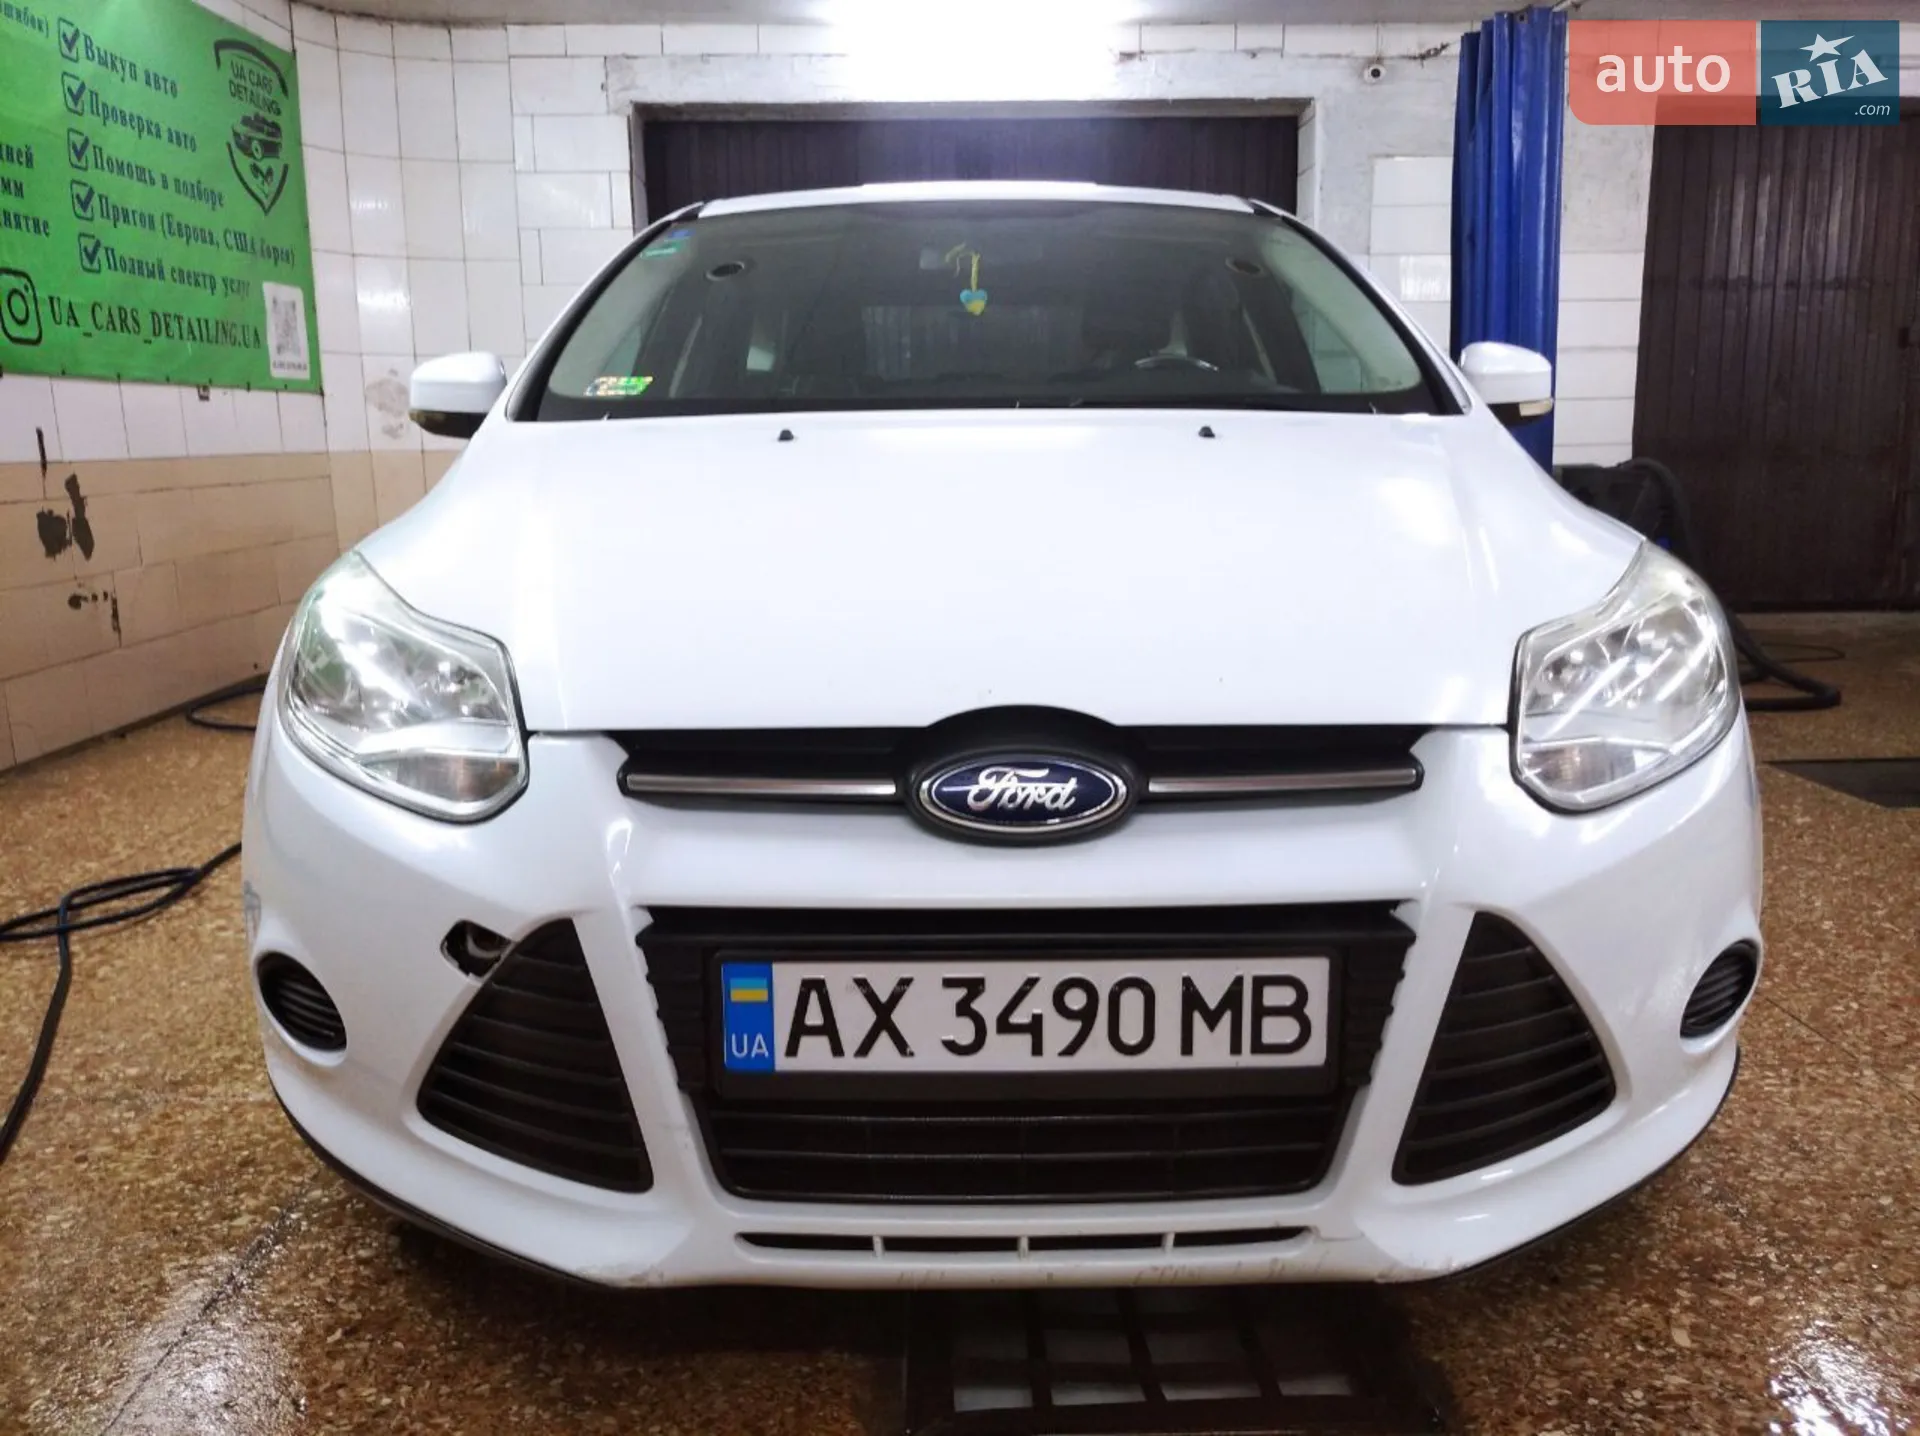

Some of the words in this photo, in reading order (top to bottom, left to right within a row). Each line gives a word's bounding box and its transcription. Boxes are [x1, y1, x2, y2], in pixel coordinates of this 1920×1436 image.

[0, 1, 49, 39] шибок)
[83, 32, 138, 83] Выкуп
[143, 68, 179, 99] авто
[89, 89, 162, 140] Проверка
[167, 127, 198, 153] авто
[0, 143, 34, 169] ней
[93, 144, 156, 187] Помощь
[160, 172, 169, 190] в
[174, 177, 224, 212] подборе
[0, 207, 50, 238] нятие
[98, 193, 156, 229] Пригон
[161, 211, 220, 250] (Европа,
[104, 245, 166, 282] Полный
[170, 265, 217, 296] спектр
[48, 296, 261, 348] UA_CARS_DETAILING.UA
[942, 766, 1078, 810] Ford
[784, 976, 914, 1058] AX
[940, 975, 1156, 1057] 3490
[1180, 974, 1312, 1057] MB
[731, 1032, 769, 1058] UA
